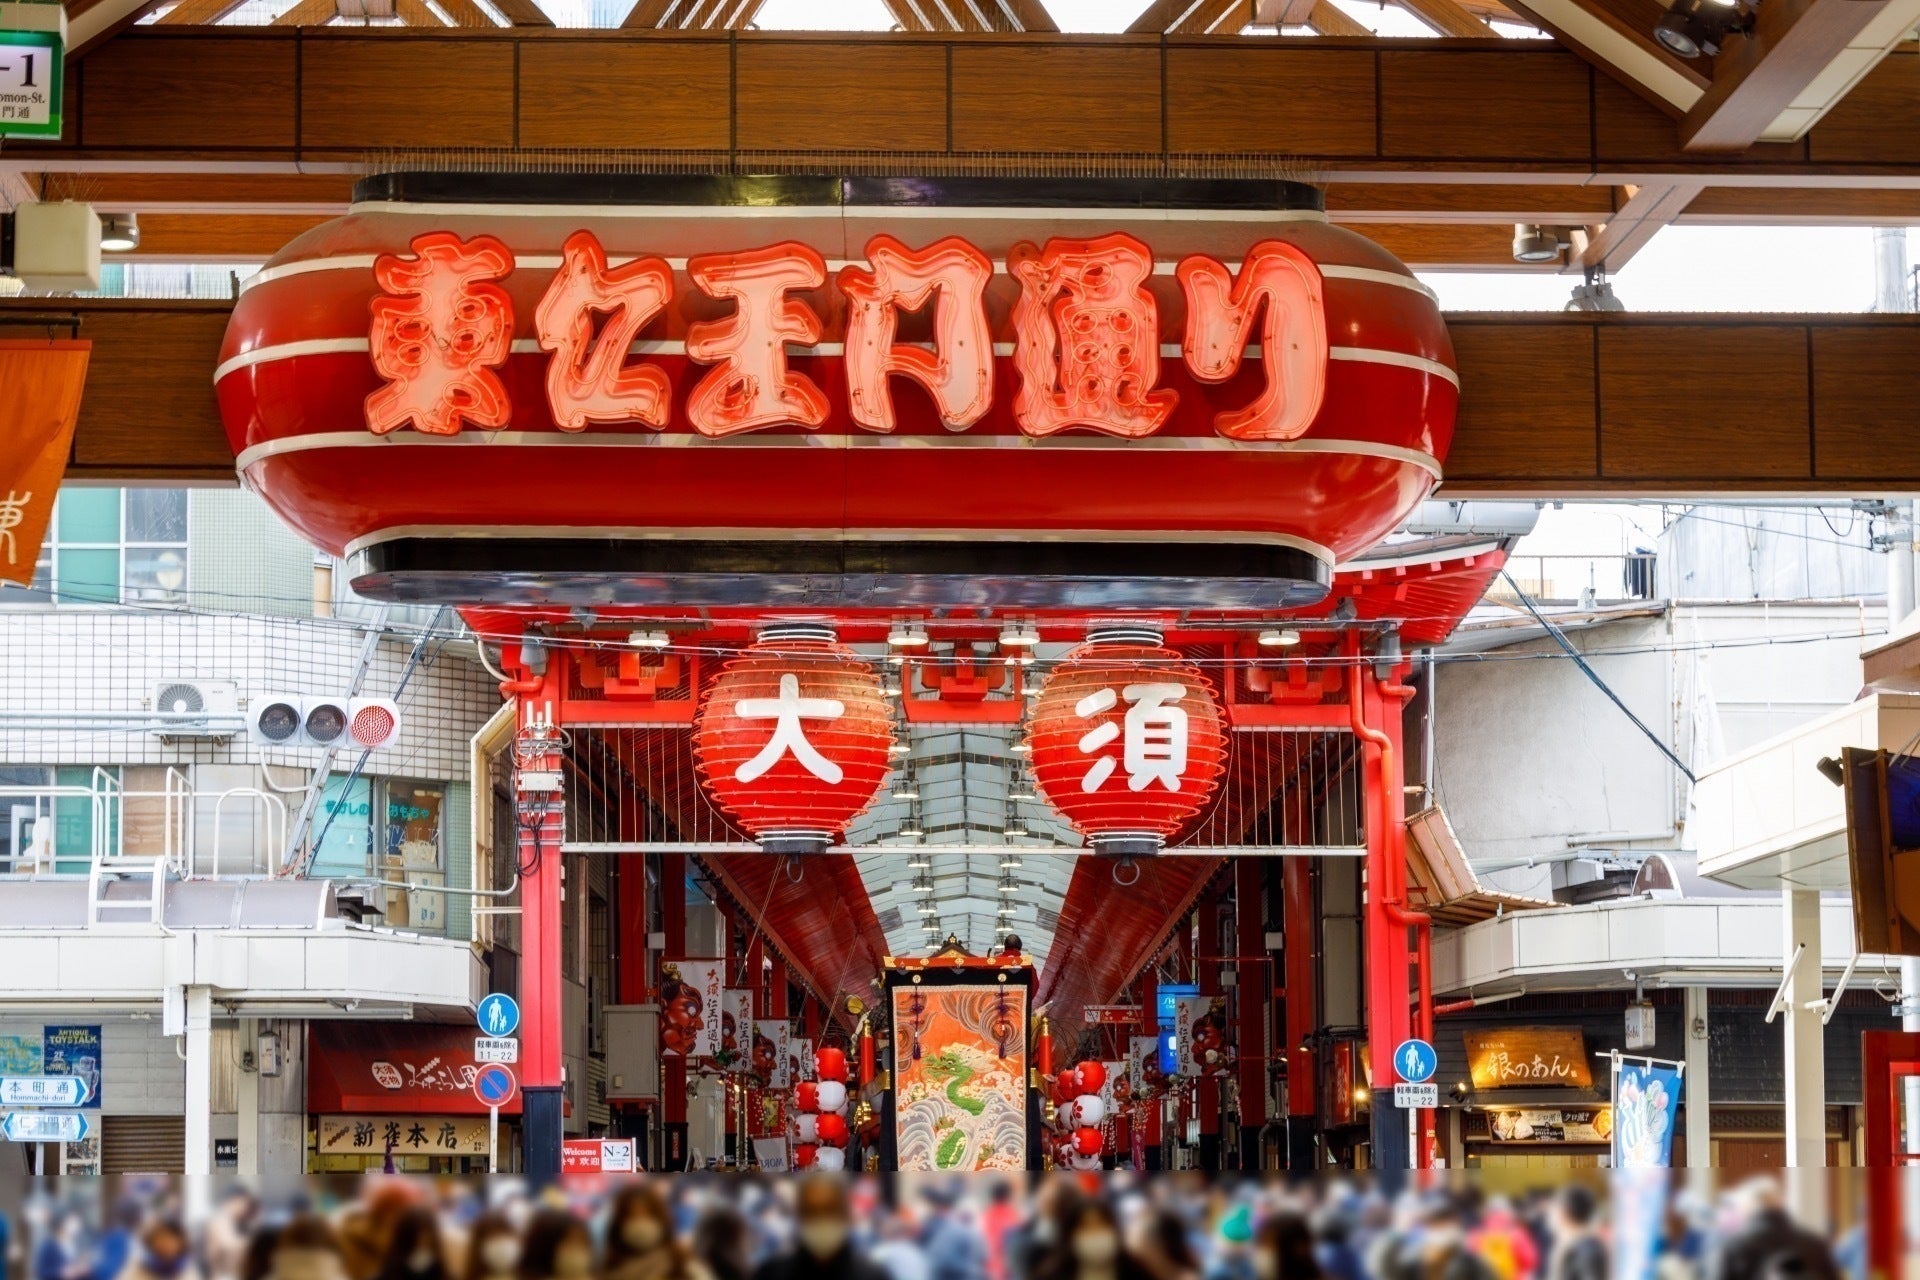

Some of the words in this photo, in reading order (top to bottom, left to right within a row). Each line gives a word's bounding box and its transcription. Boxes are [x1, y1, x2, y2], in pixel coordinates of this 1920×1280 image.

[363, 228, 1332, 443] 東仁王門通り
[734, 673, 846, 785] 大
[1074, 682, 1188, 794] 須
[49, 1034, 97, 1044] TOYSTALK
[8, 1081, 69, 1094] 本町通
[353, 1121, 458, 1150] 新雀本店
[563, 1147, 597, 1156] Welcome
